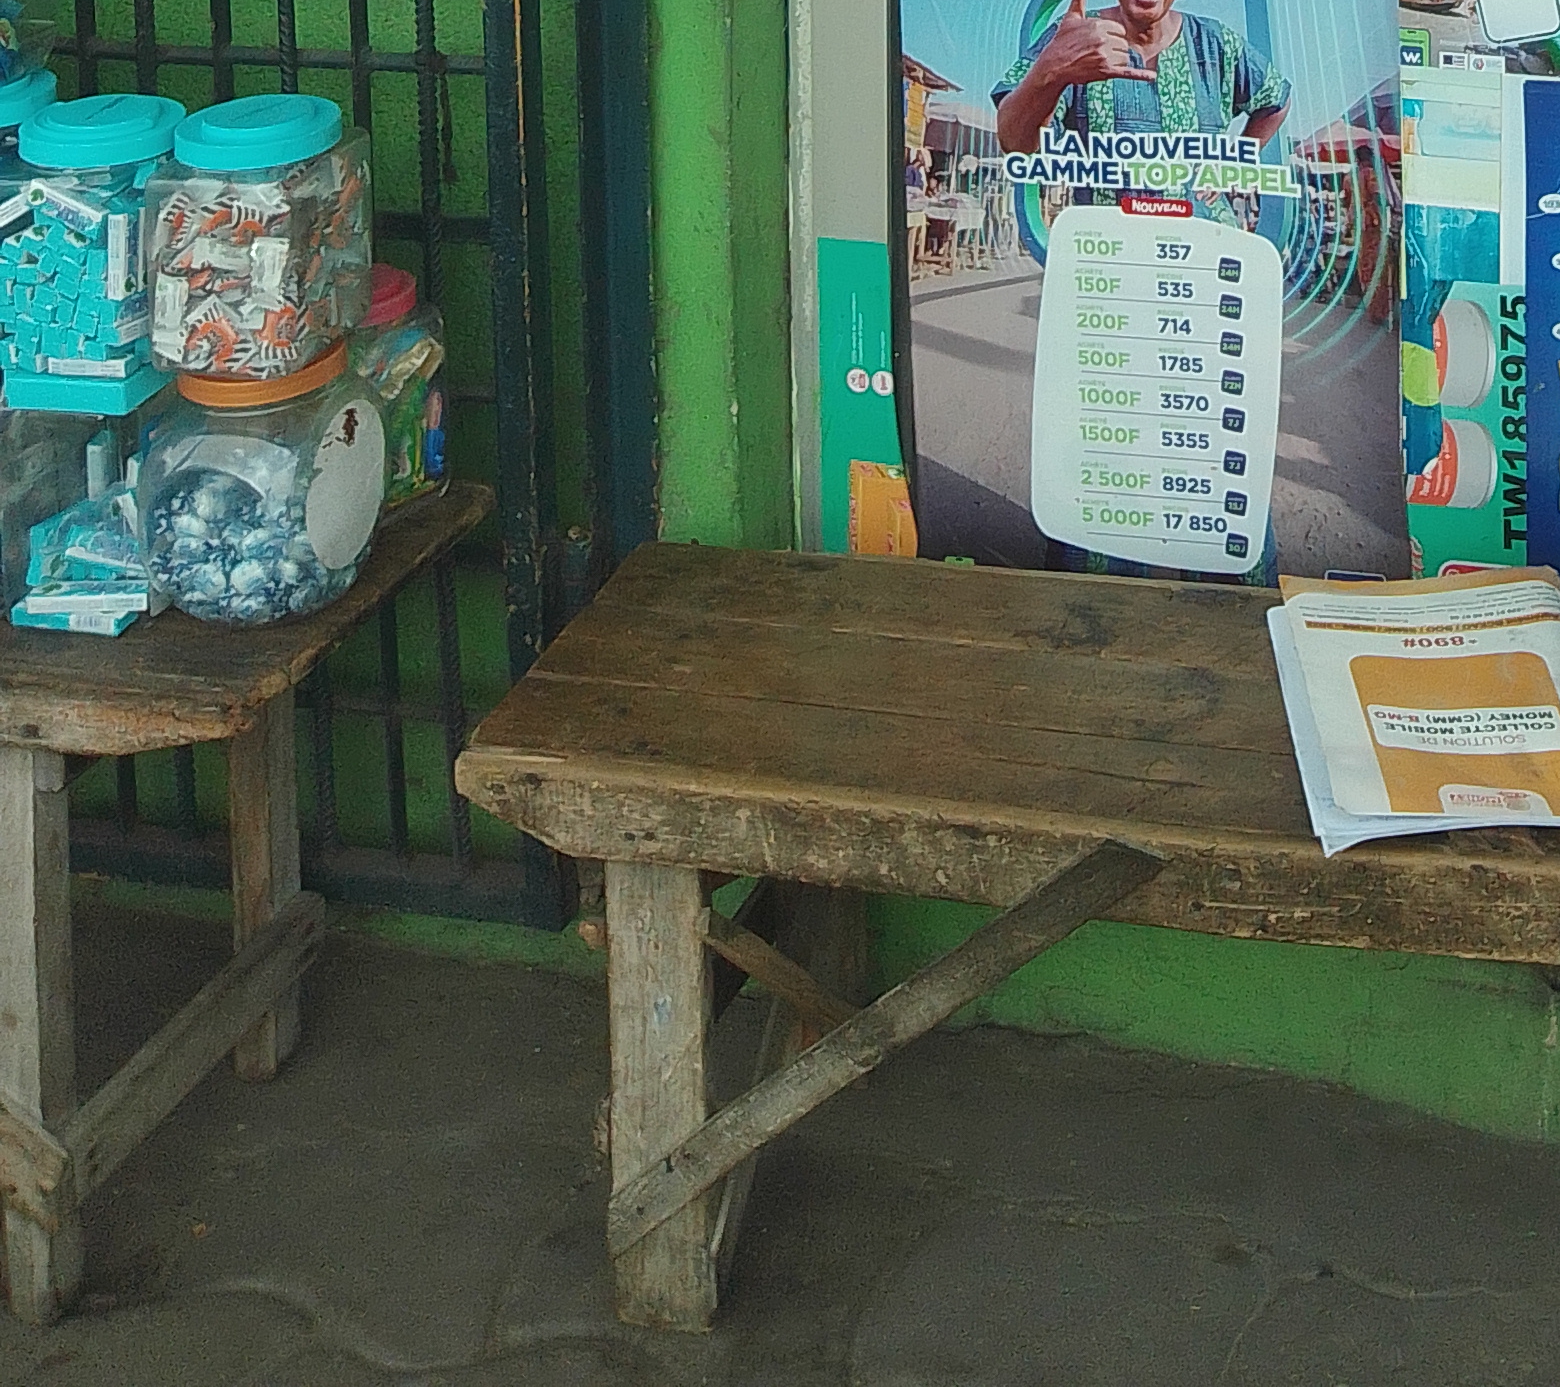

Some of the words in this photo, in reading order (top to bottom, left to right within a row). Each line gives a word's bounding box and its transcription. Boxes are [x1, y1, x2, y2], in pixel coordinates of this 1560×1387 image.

[1043, 129, 1079, 155] LA
[1089, 132, 1257, 165] NOUVELLE
[1006, 155, 1125, 185] GAMME
[1130, 163, 1190, 187] TOP
[1197, 165, 1300, 194] APPEL
[1131, 200, 1187, 215] NOUVEAU
[1074, 238, 1123, 256] 100F
[1156, 243, 1191, 260] 357
[1075, 276, 1121, 293] 150F
[1157, 281, 1193, 298] 535
[1076, 312, 1129, 330] 200F
[1158, 317, 1191, 334] 714
[1078, 350, 1130, 368] 500F
[1158, 355, 1203, 373] 1785
[1078, 387, 1141, 407] 1000F
[1160, 393, 1209, 411] 3570
[1079, 425, 1140, 444] 1500F
[1161, 431, 1209, 449] 5355
[1162, 476, 1211, 494] 8925
[1489, 710, 1553, 721] MONEY
[1385, 721, 1454, 734] MOBILE
[1461, 721, 1556, 733] COLLECTE
[1443, 735, 1527, 747] SOLUTION
